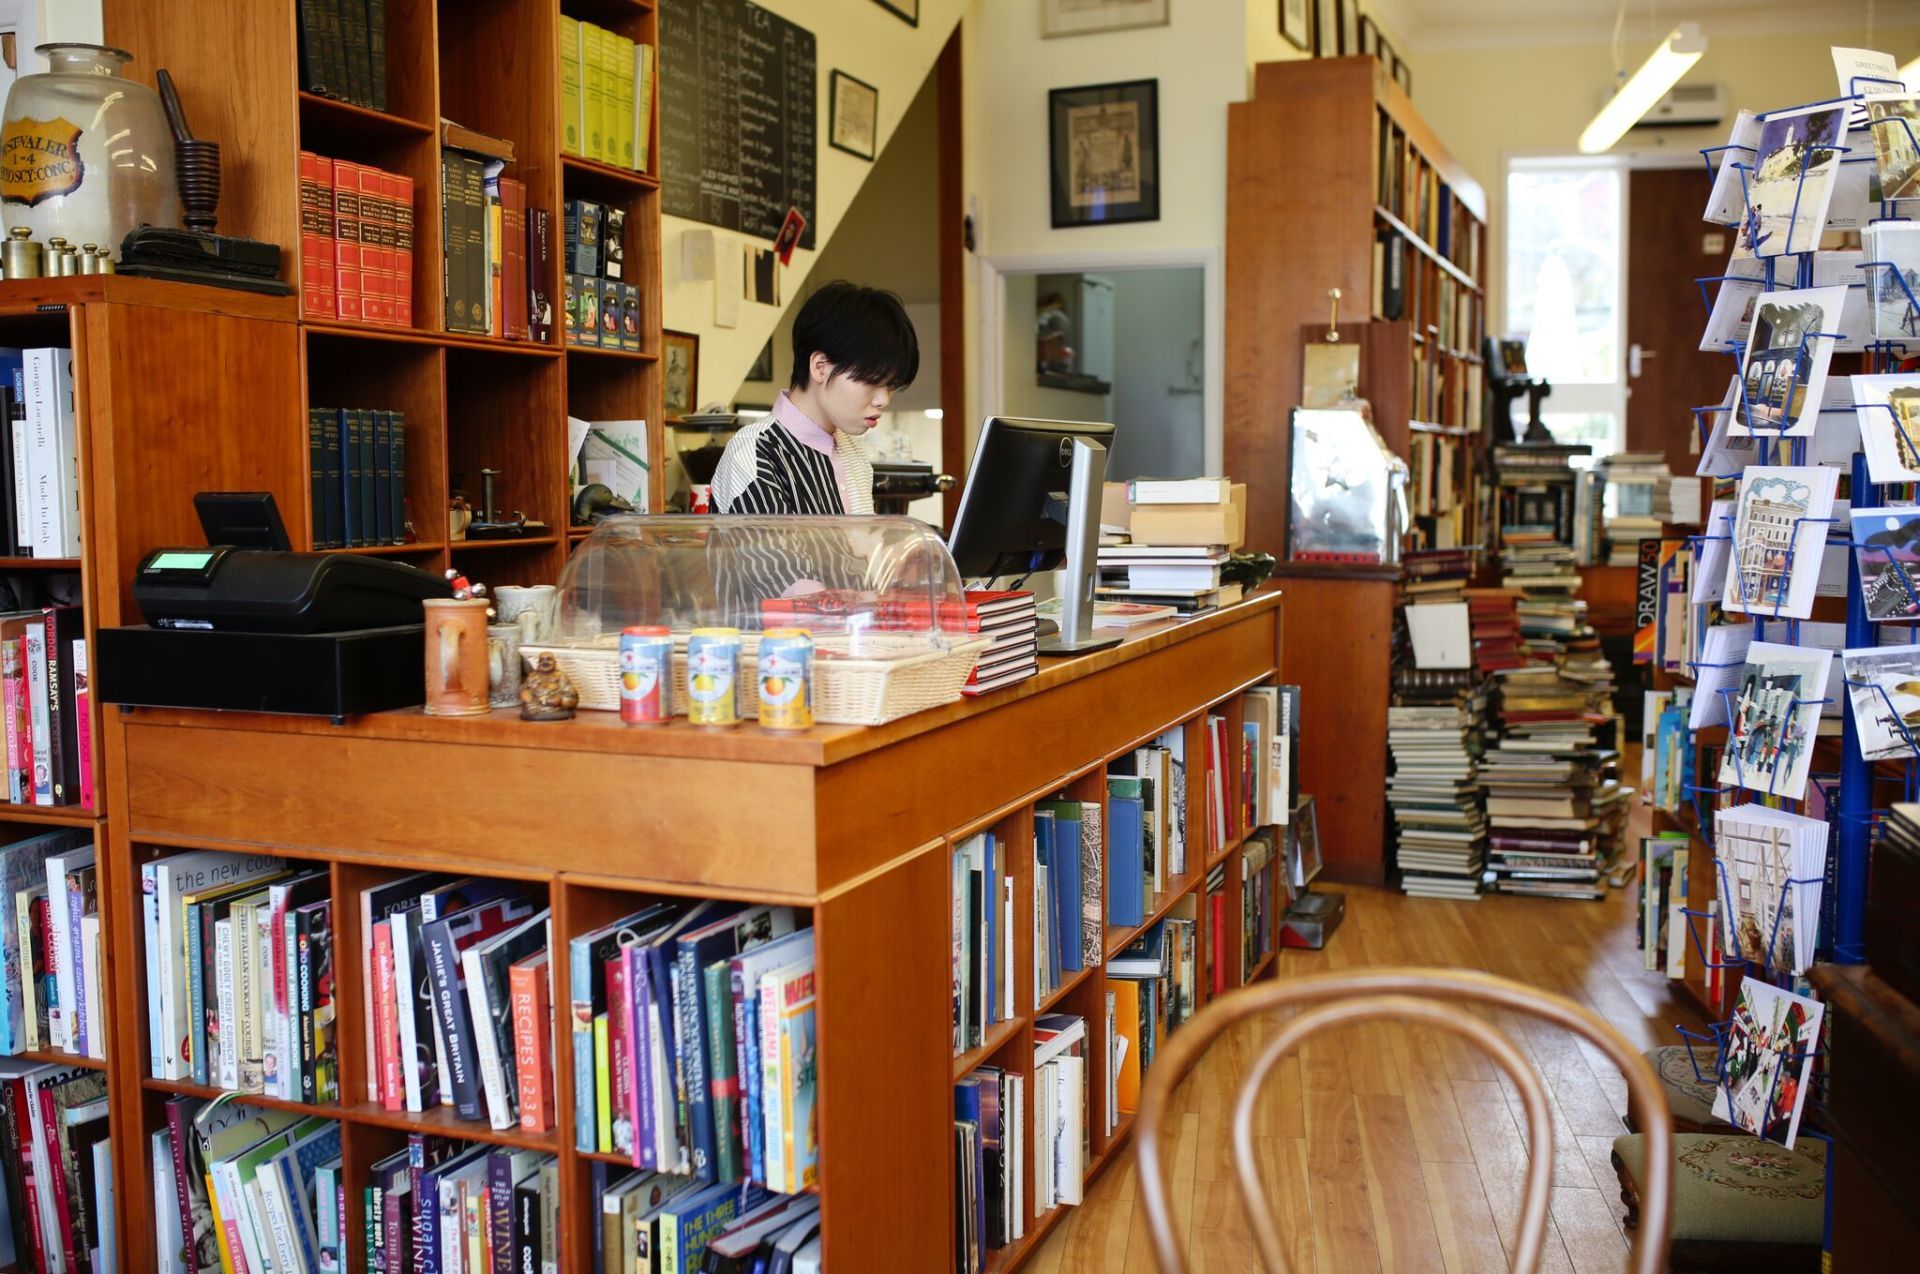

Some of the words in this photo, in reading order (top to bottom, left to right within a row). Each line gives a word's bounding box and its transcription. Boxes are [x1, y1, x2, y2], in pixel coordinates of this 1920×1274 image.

[15, 372, 23, 402] GORDON
[32, 357, 43, 397] Giorgio
[35, 400, 45, 448] Locatelli
[39, 473, 50, 503] Made
[40, 506, 50, 519] In
[41, 521, 51, 545] Italy
[1641, 540, 1659, 562] 50
[1637, 563, 1657, 629] DRAW
[46, 616, 56, 660] GORDON
[47, 660, 59, 712] RAMSAY'S
[5, 704, 18, 766] cupcakes
[82, 736, 91, 762] food
[176, 872, 204, 892] the
[211, 863, 241, 881] new
[189, 919, 199, 955] PASSION
[240, 912, 248, 933] THE
[47, 933, 57, 973] Cooker
[222, 927, 231, 957] CHEWY
[241, 935, 250, 974] ITALIAN
[287, 934, 295, 954] THE
[378, 941, 386, 954] The
[191, 959, 199, 977] FOR
[223, 960, 232, 989] GOOEY
[288, 957, 296, 981] BUSY
[192, 980, 201, 1032] VEGETABLES
[242, 975, 250, 1019] COOKERY
[289, 984, 297, 1015] MUM'S
[300, 965, 309, 1012] COOKING
[223, 992, 233, 1023] CRISPY
[431, 940, 447, 987] JAMIE'S
[441, 990, 455, 1031] GREAT
[448, 1034, 465, 1084] BRITAIN
[734, 1002, 745, 1042] kitchen
[764, 986, 776, 1060] WELIGAMA
[225, 1025, 234, 1067] CRUNCHY
[243, 1021, 252, 1057] COURSE
[290, 1017, 299, 1069] COOKBOOK
[517, 994, 534, 1065] RECIPES
[737, 1044, 747, 1090] seasons
[168, 1120, 177, 1136] MY
[998, 1075, 1006, 1187] LONDON
[171, 1140, 180, 1164] LAST
[175, 1169, 185, 1207] SUPPER
[372, 1187, 383, 1221] thirsty
[263, 1191, 278, 1225] Recipes
[684, 1215, 703, 1237] THE
[705, 1197, 736, 1226] THREE
[181, 1214, 192, 1259] MELANIE
[227, 1227, 237, 1244] LIFE
[273, 1227, 283, 1242] For
[374, 1223, 384, 1247] work
[388, 1221, 398, 1236] TO
[421, 1198, 435, 1255] sugar
[494, 1209, 512, 1272] WINE
[230, 1245, 238, 1254] IS
[276, 1242, 288, 1268] Every
[412, 1216, 424, 1274] WINE
